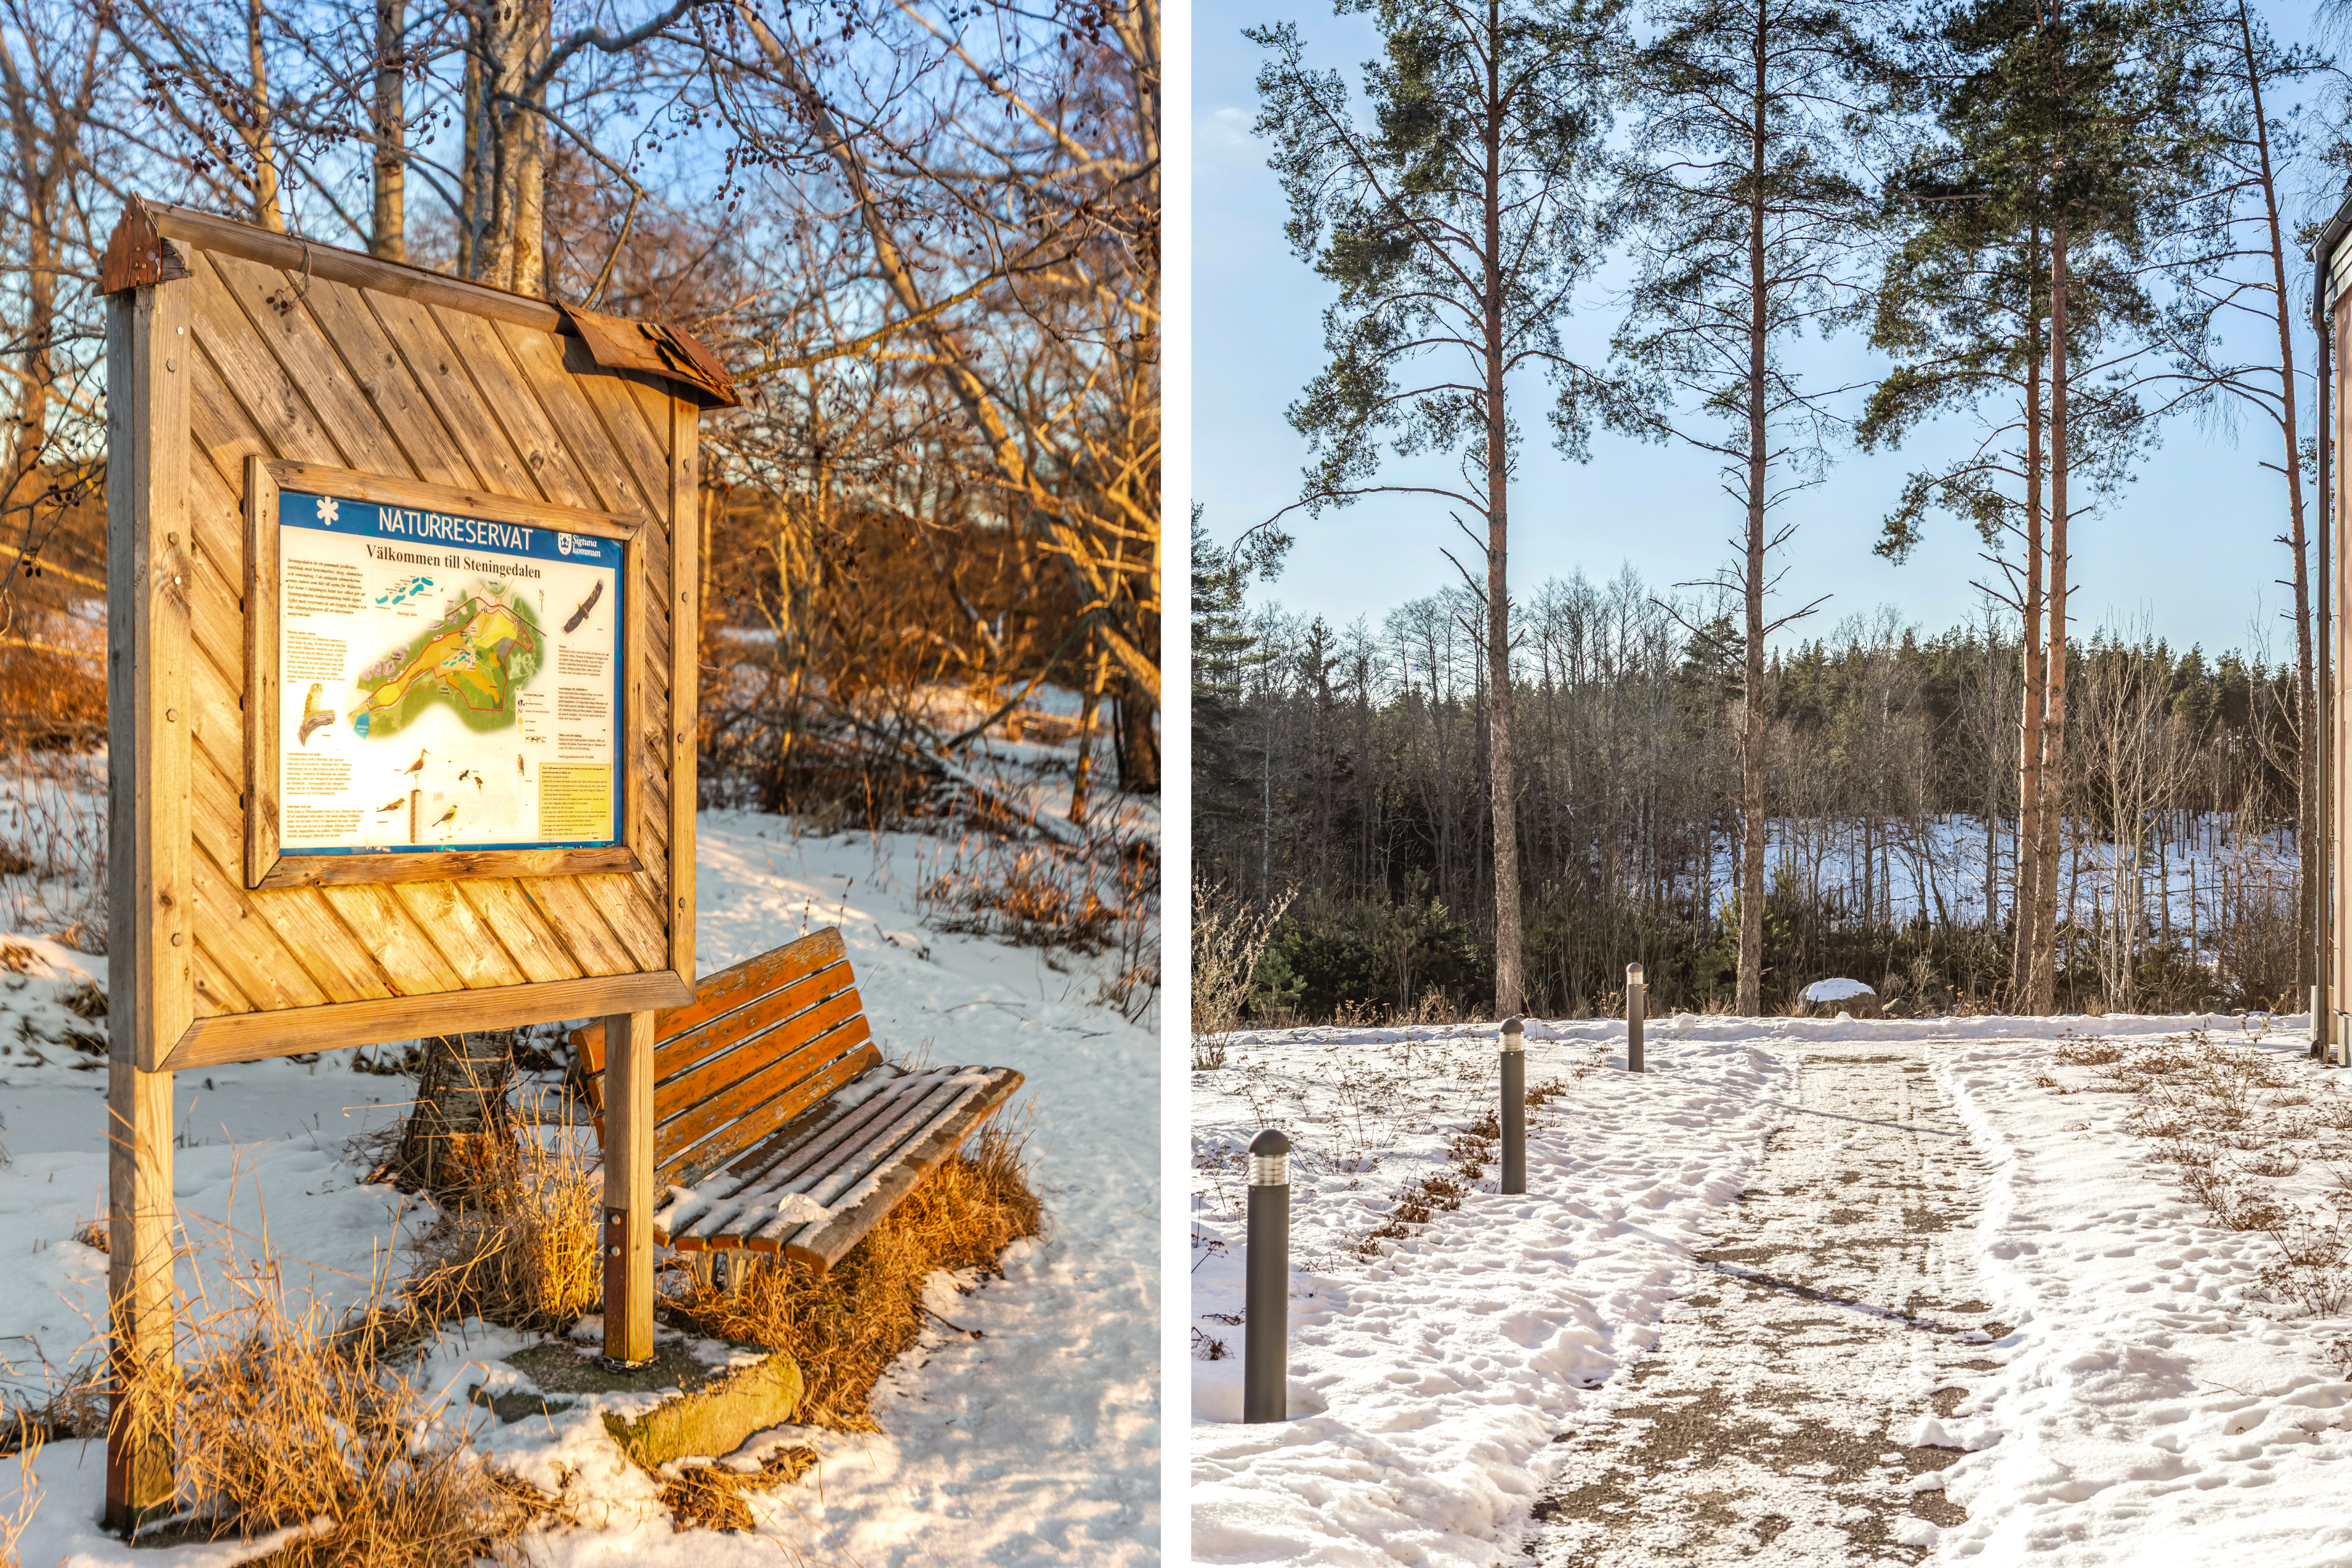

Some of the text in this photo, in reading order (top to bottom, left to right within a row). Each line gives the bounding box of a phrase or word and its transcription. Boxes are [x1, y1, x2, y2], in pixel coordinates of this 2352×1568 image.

[380, 507, 533, 550] NATURRESERVAT
[573, 534, 597, 547] Sigtuna
[366, 544, 541, 579] Välkommen till Steningedalen
[572, 544, 601, 557] kommun
